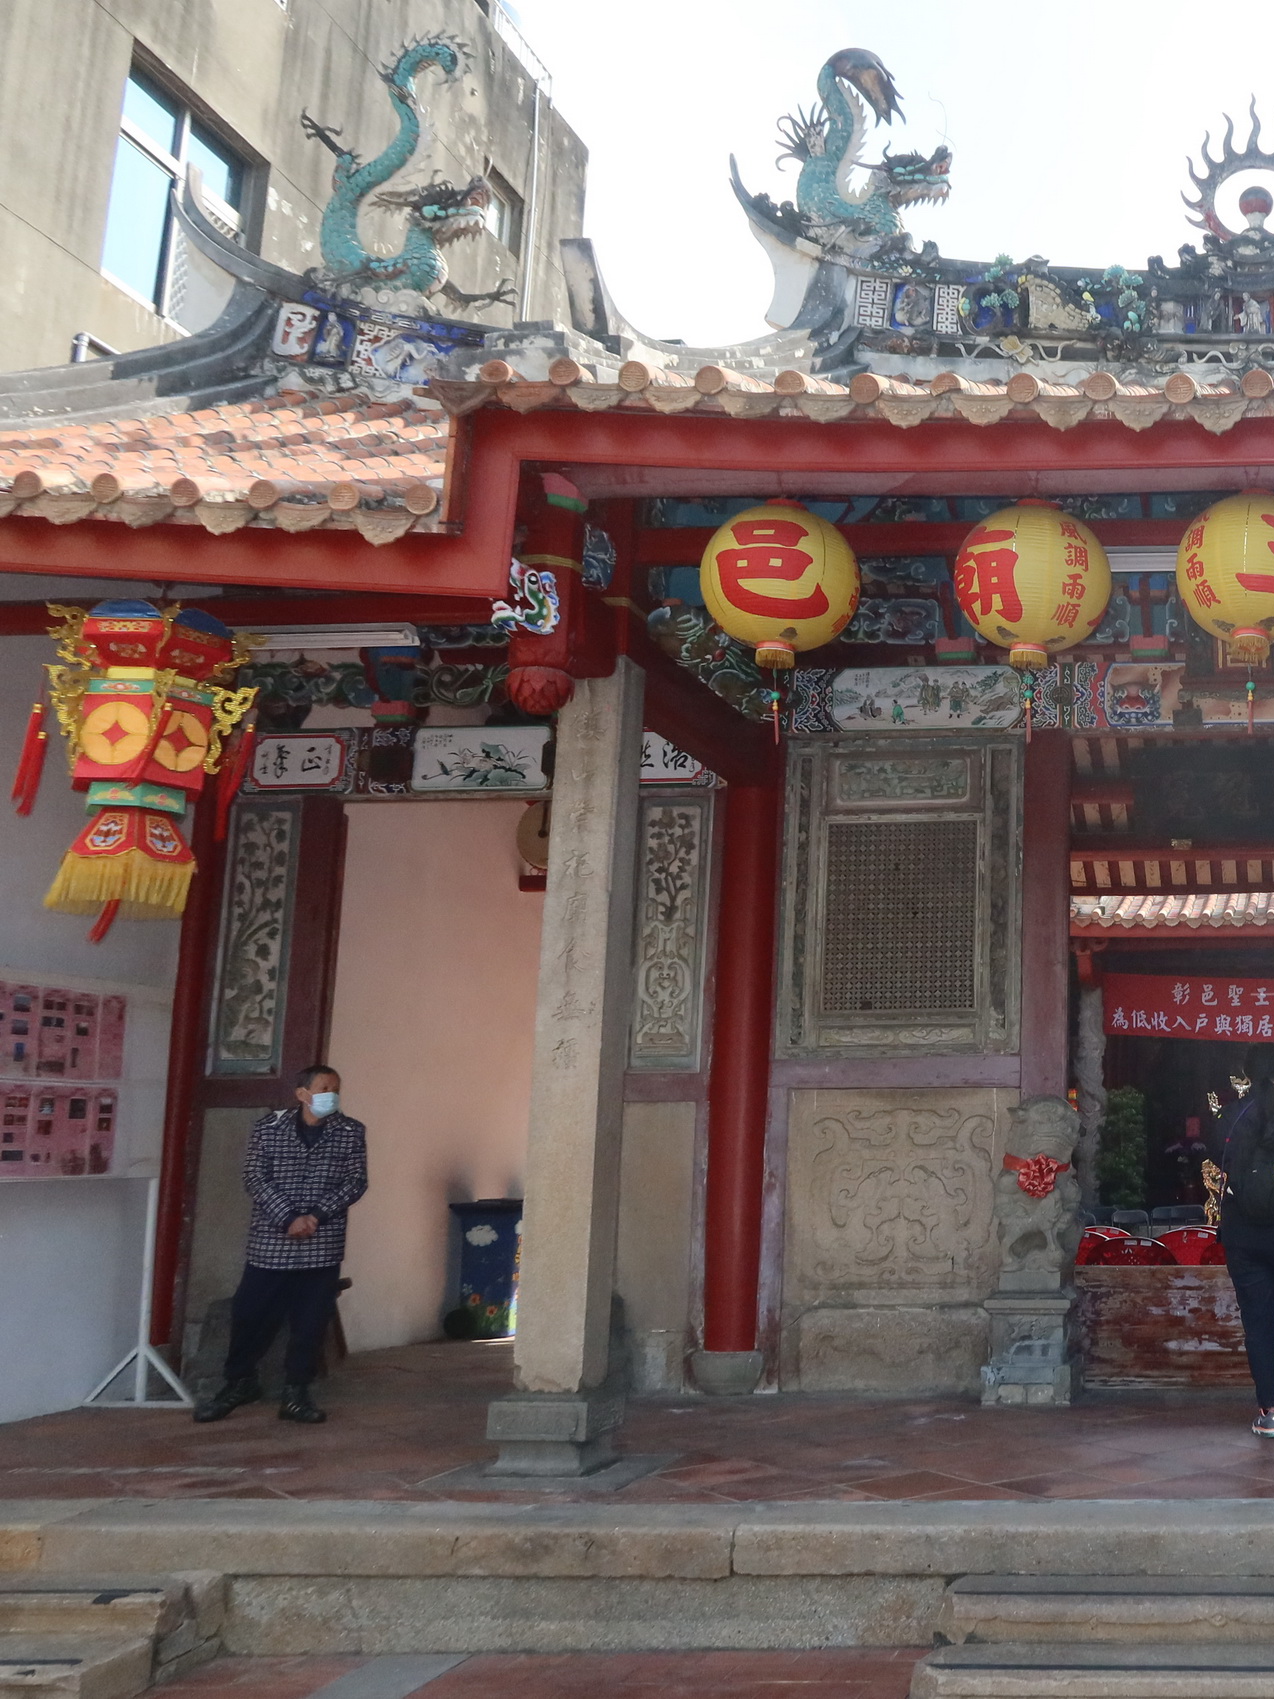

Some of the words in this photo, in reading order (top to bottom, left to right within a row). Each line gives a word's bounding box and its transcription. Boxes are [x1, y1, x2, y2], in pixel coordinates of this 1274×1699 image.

[715, 519, 829, 619] 邑
[955, 526, 1023, 625] 廟
[1051, 521, 1089, 628] 風調雨順
